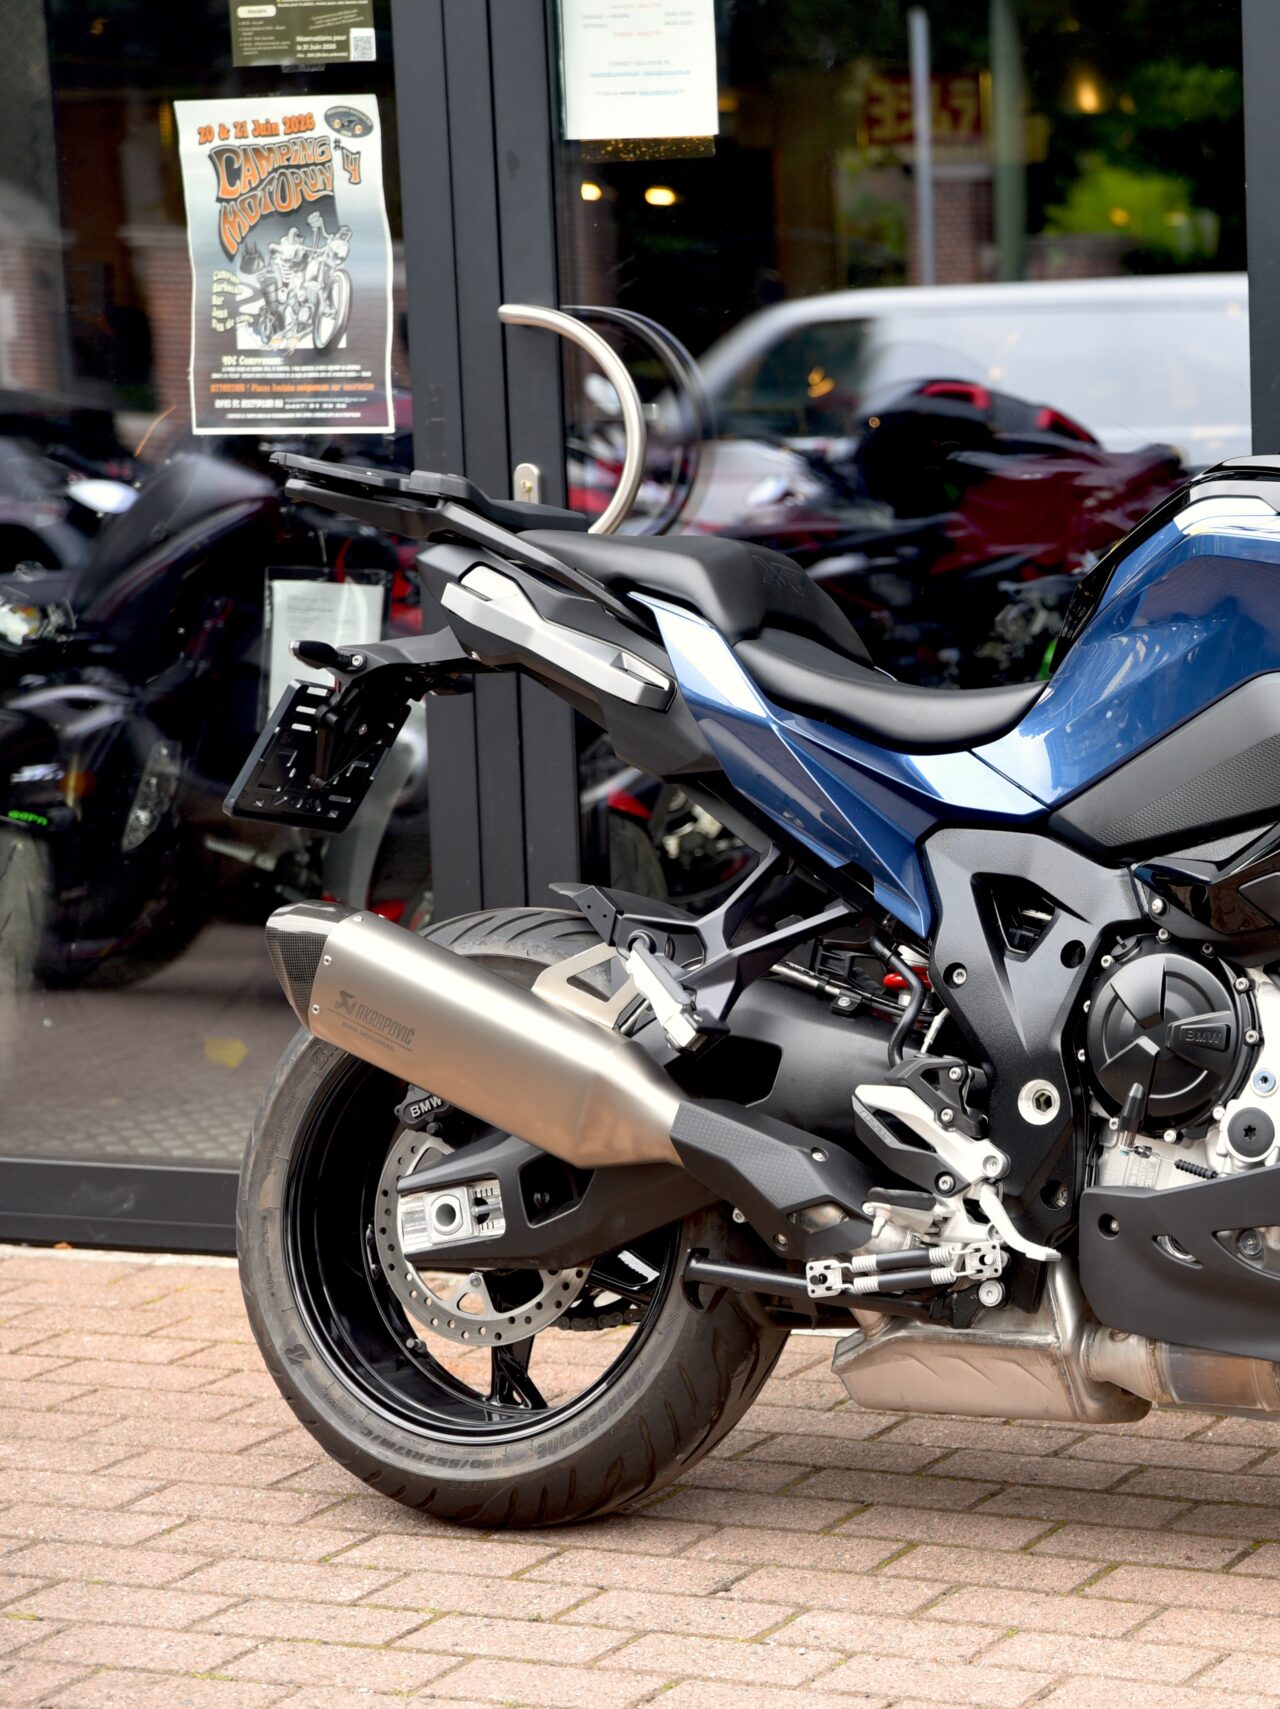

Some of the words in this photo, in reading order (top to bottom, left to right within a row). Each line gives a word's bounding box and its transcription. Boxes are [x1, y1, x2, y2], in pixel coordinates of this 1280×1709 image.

[198, 125, 215, 144] 20
[218, 123, 230, 140] &
[234, 120, 250, 139] 21
[252, 117, 280, 137] Juin
[282, 112, 316, 134] 2026
[209, 136, 333, 200] CAMPING
[219, 162, 334, 258] MOTORUN
[1184, 1030, 1222, 1044] BMW
[409, 1095, 442, 1118] BMW
